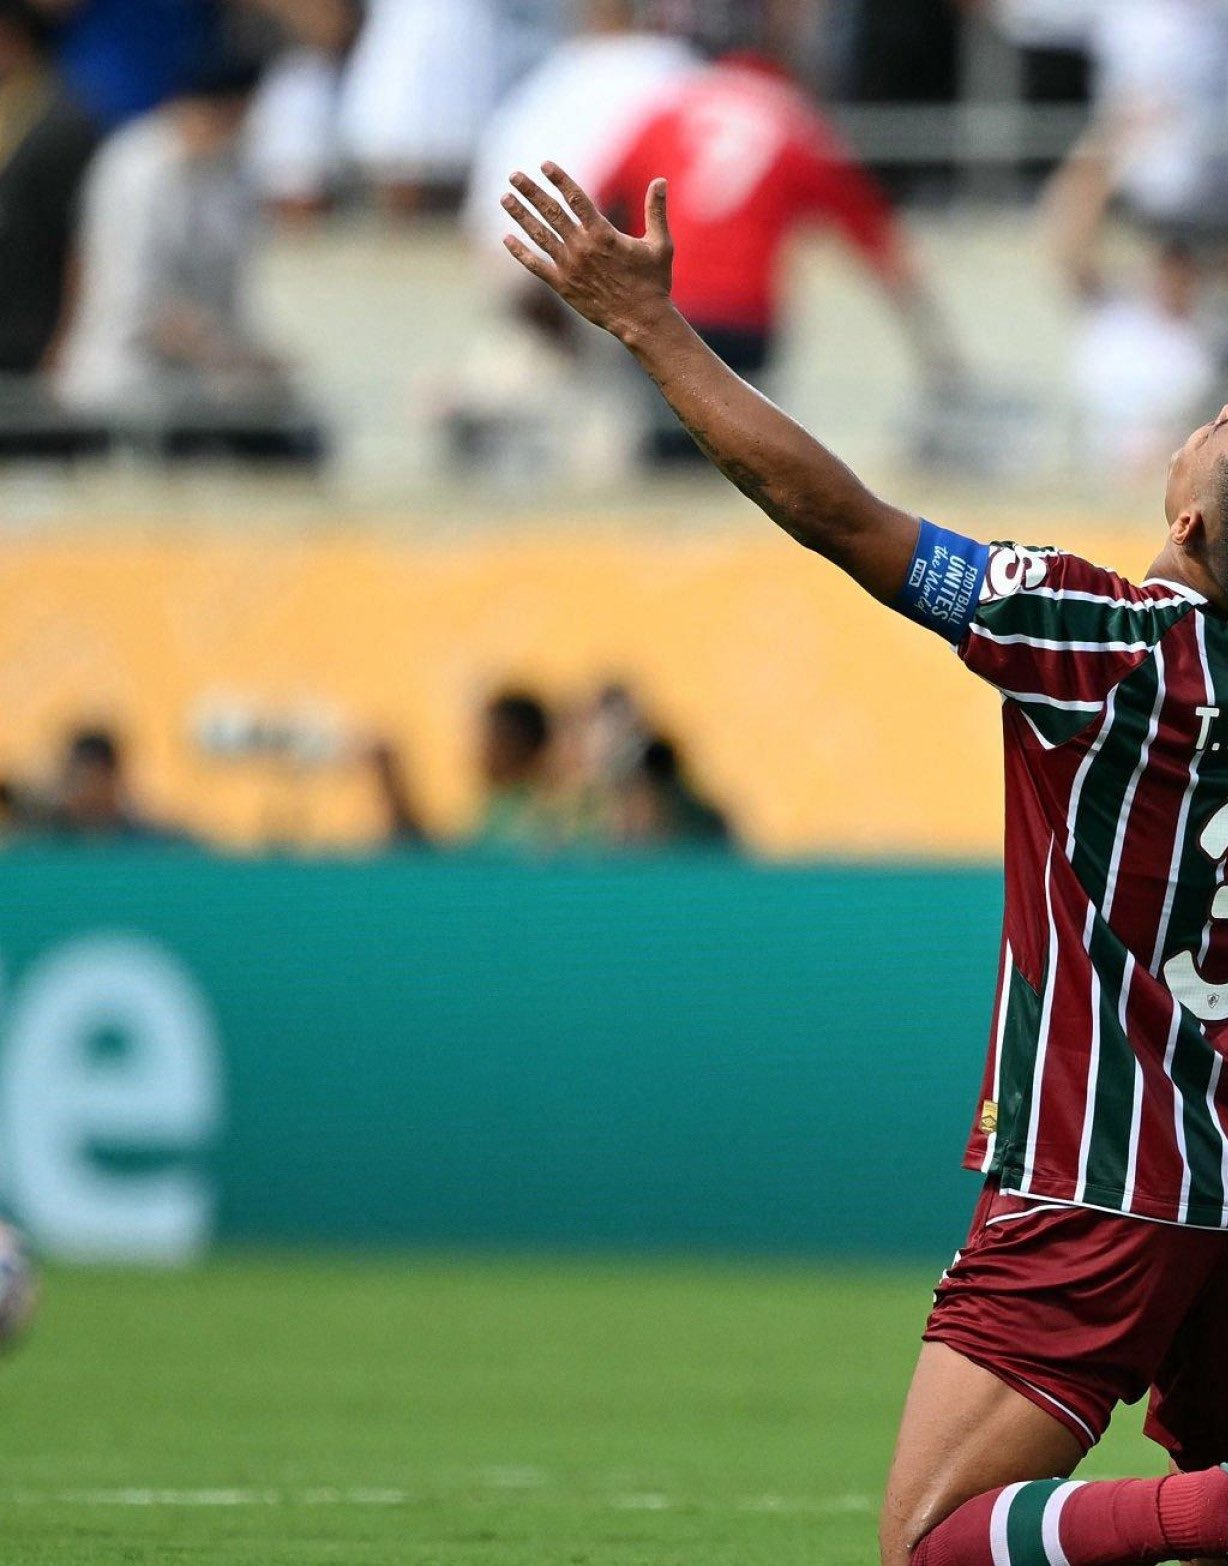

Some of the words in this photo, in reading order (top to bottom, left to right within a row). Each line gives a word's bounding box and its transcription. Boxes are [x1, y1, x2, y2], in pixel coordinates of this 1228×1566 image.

[931, 555, 967, 620] UNITES
[932, 545, 949, 568] the
[948, 563, 977, 624] FOOTBALL
[0, 931, 222, 1264] e
